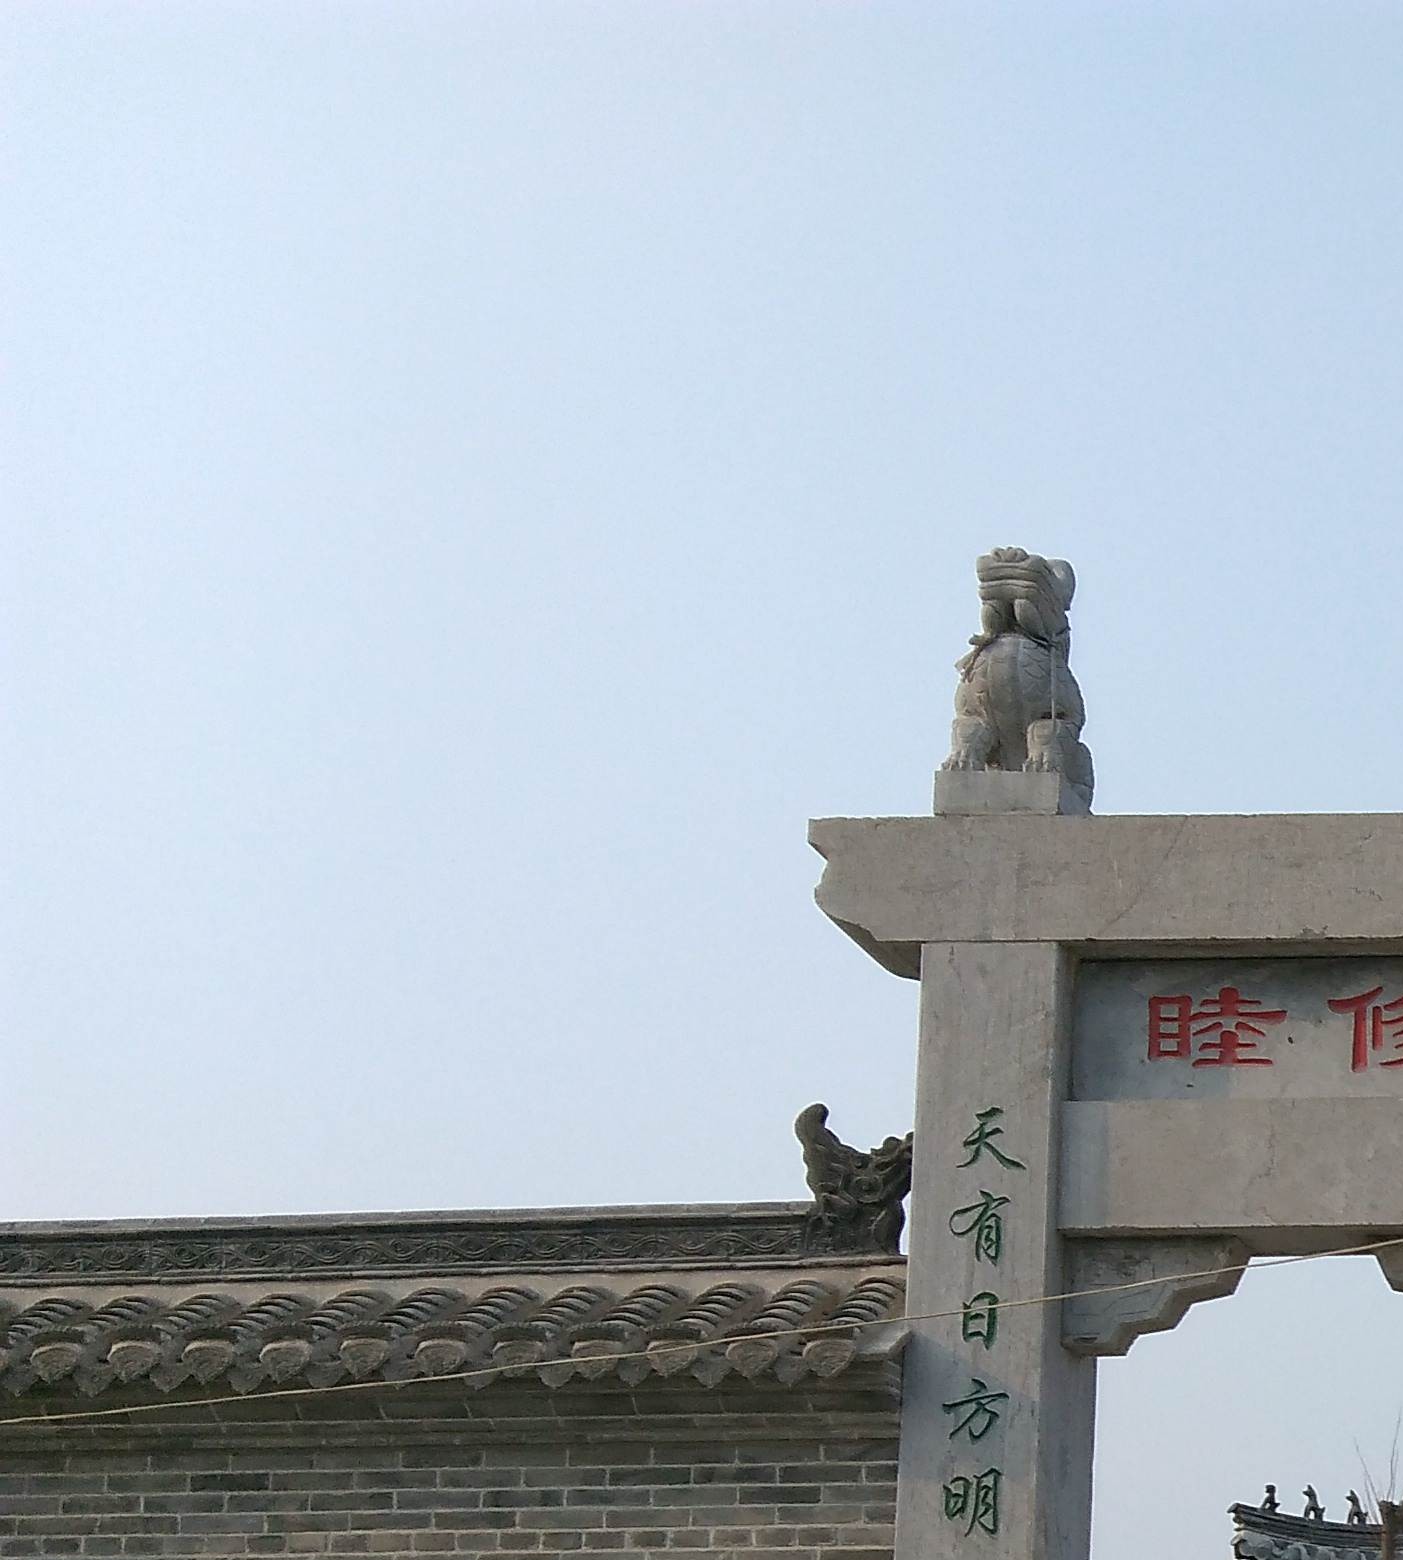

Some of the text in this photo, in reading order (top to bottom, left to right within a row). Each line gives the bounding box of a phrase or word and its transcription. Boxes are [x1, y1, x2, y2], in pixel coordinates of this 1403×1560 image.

[943, 1105, 1026, 1537] 天有日方明
